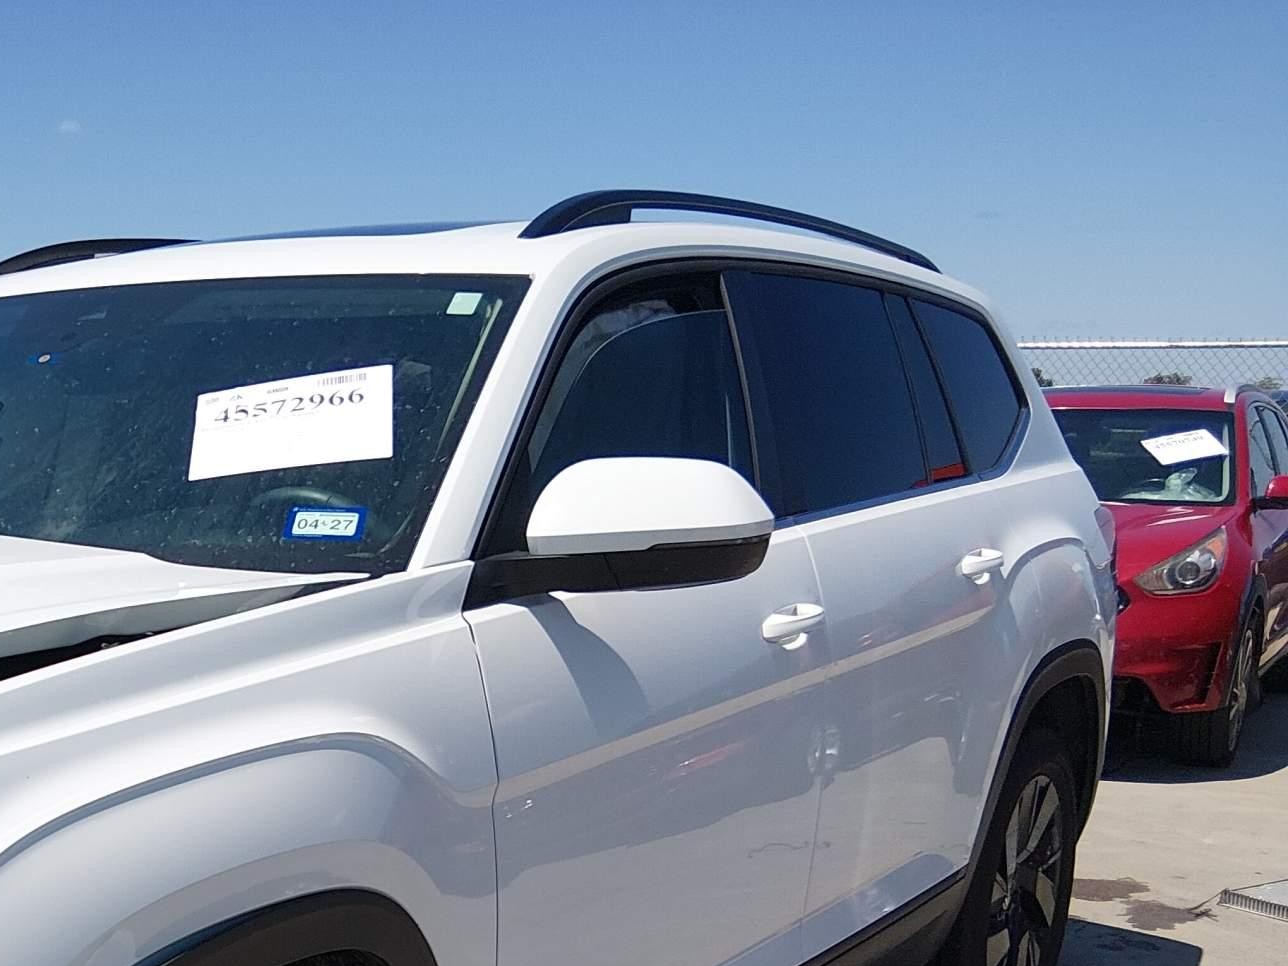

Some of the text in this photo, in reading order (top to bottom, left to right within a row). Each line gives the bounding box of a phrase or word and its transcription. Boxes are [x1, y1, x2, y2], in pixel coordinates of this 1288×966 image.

[214, 388, 365, 424] 45572966
[297, 518, 354, 531] 04 27
